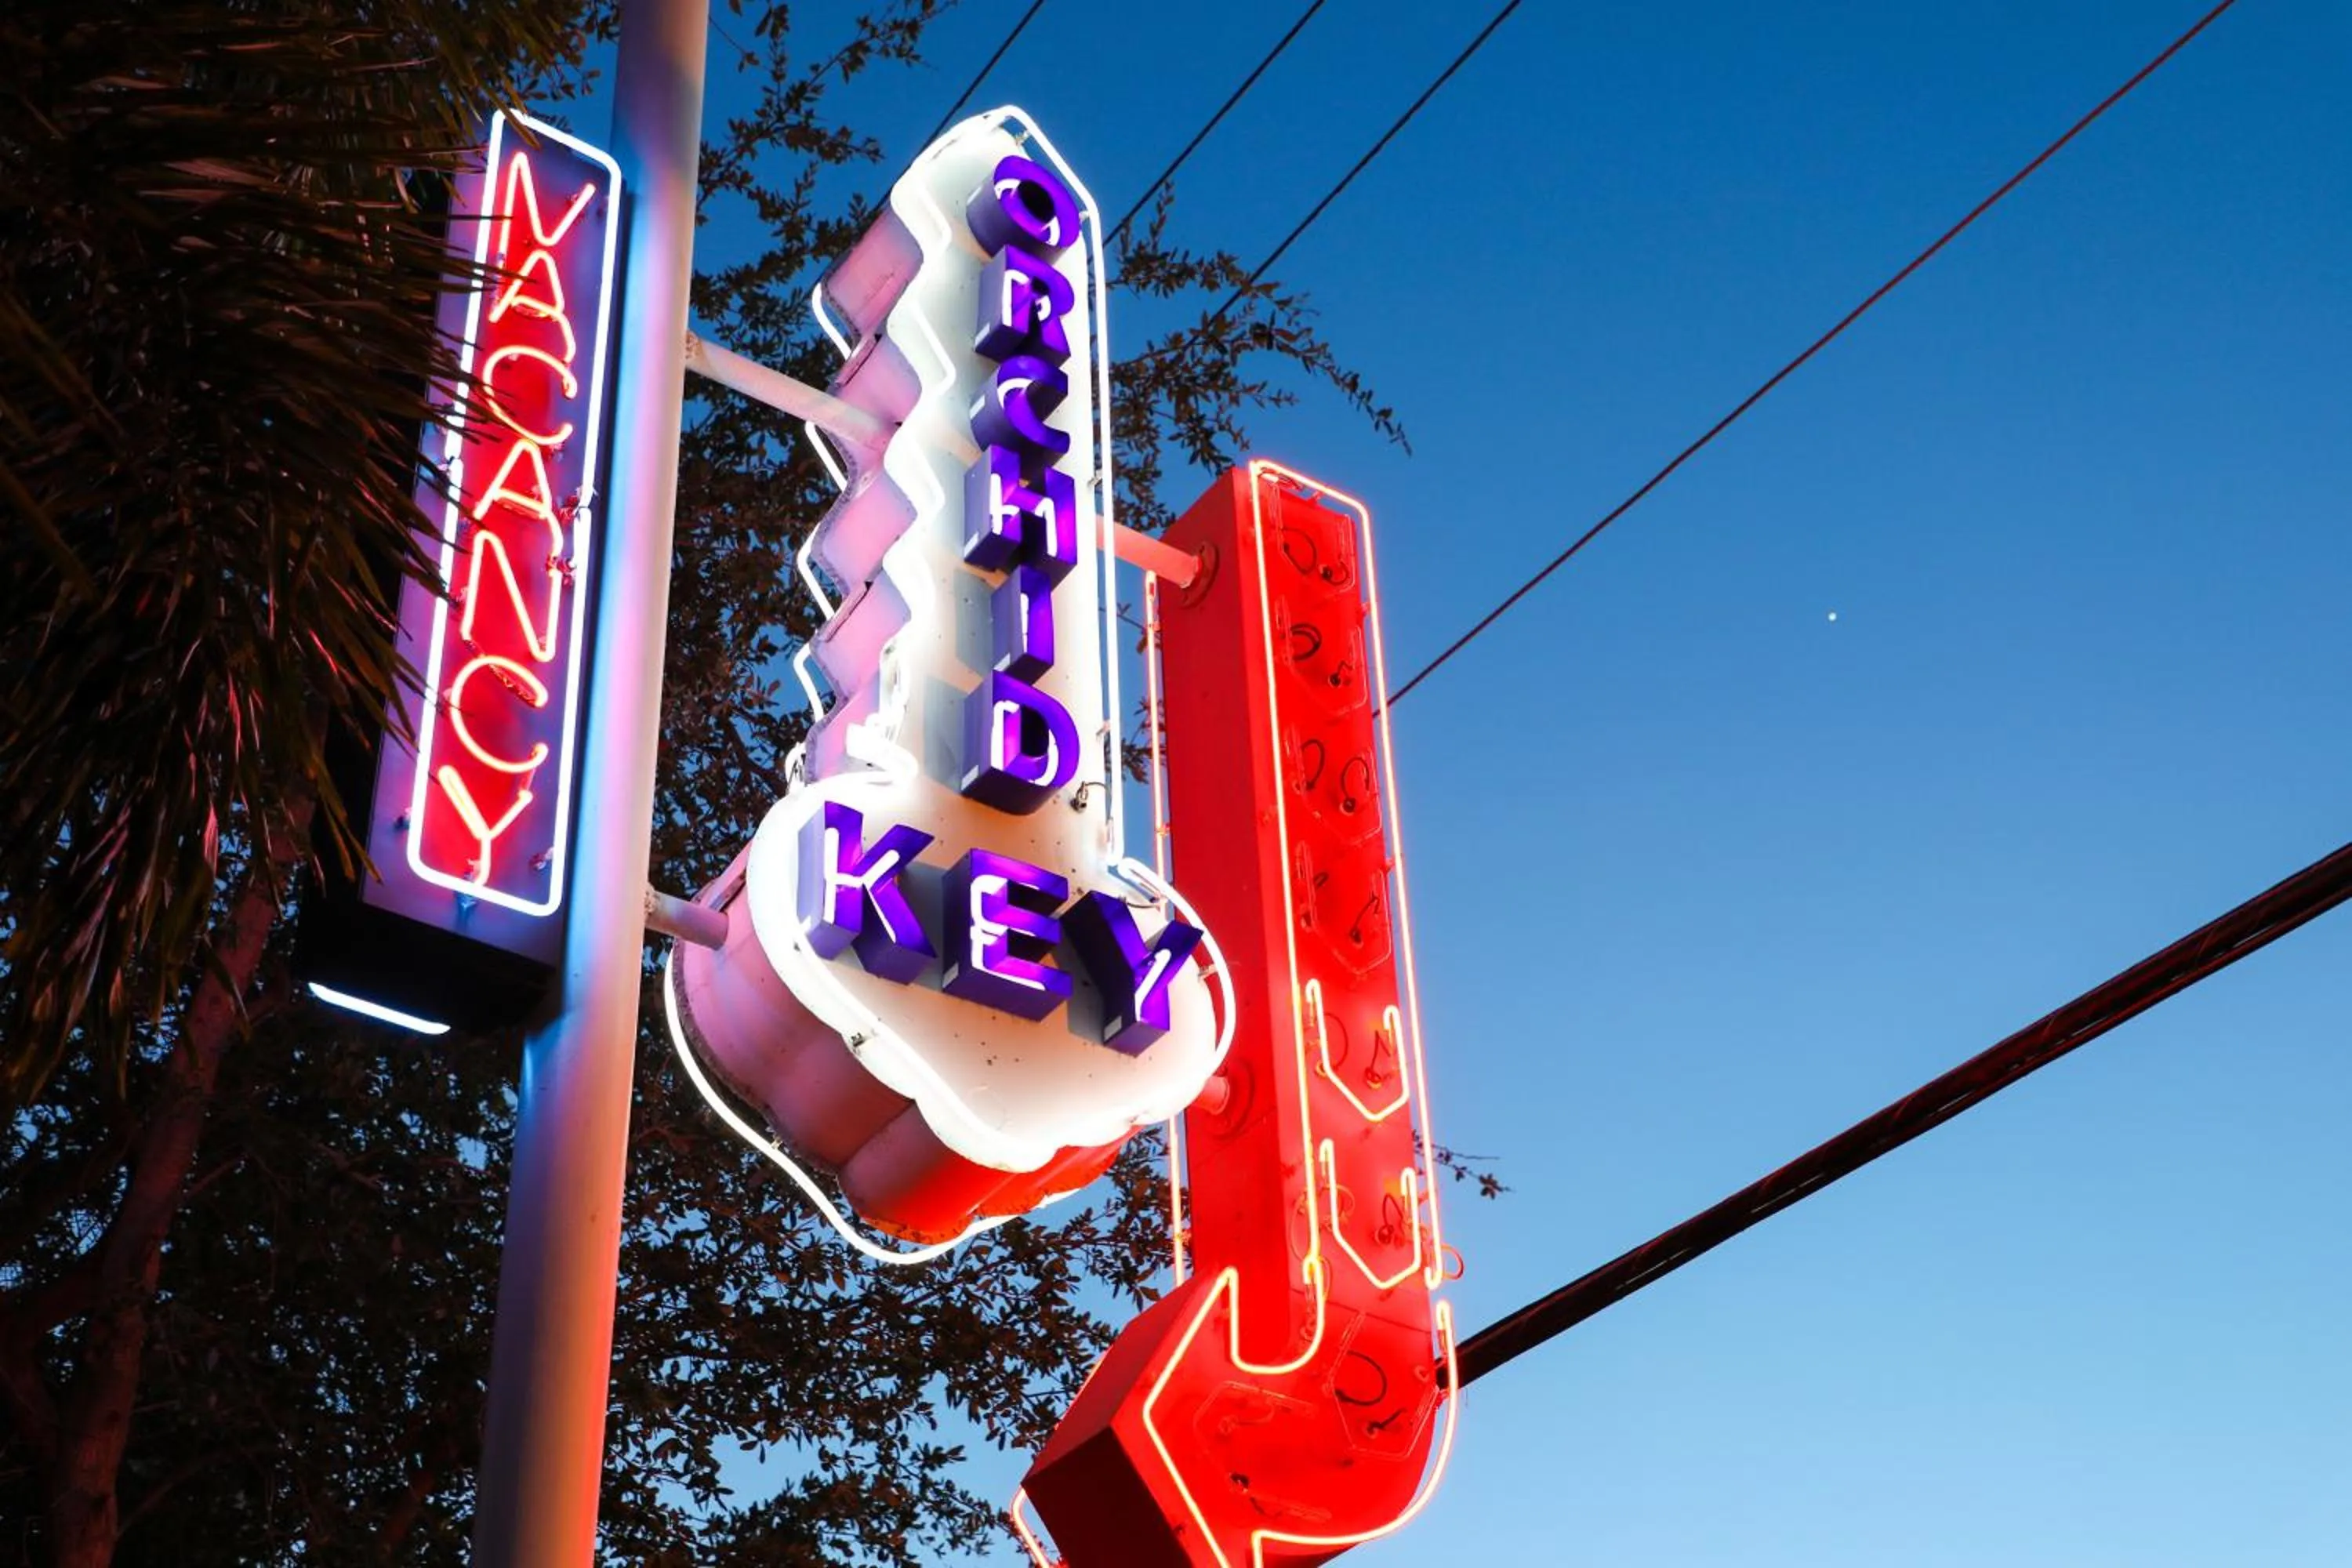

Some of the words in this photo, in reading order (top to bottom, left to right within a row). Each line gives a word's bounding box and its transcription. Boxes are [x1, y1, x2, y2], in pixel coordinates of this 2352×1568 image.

[438, 152, 596, 887] VACANCY
[961, 154, 1081, 816] ORCHID
[796, 800, 1205, 1058] KEY
